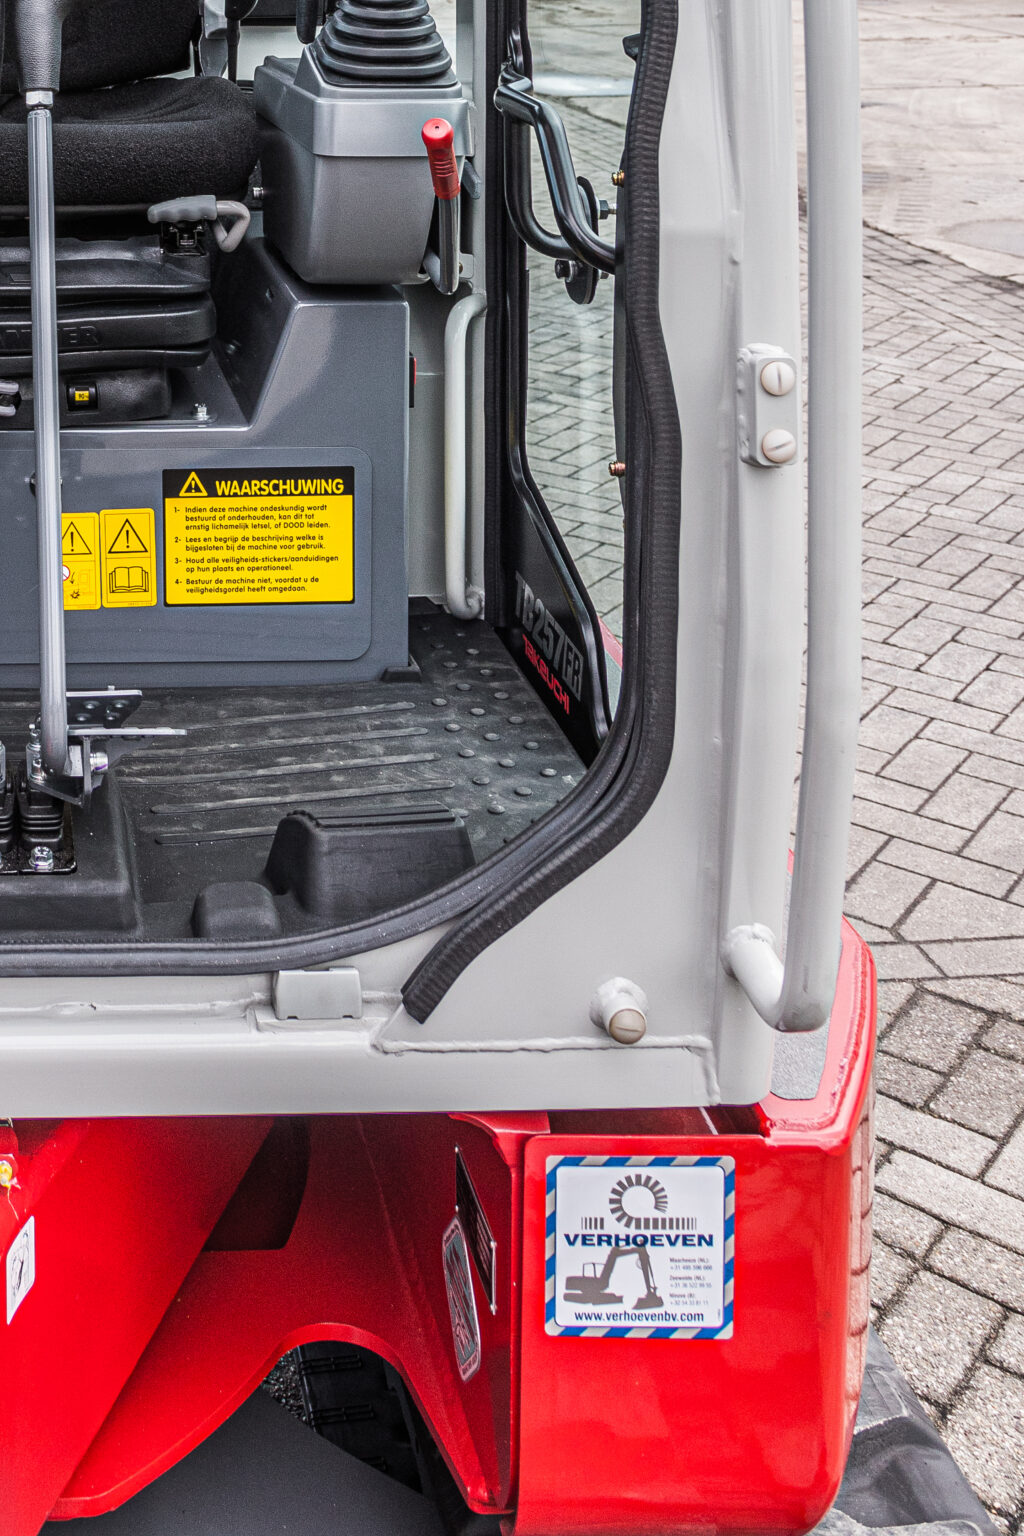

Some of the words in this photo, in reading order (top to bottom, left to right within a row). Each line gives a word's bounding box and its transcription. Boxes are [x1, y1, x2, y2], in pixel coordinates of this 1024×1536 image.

[215, 478, 345, 496] WAARSCHUWING
[260, 504, 305, 513] ondeskundig
[227, 513, 276, 521] onderhouden,
[185, 524, 210, 532] ernstig
[251, 522, 272, 530] letsel,
[283, 521, 305, 529] DOOD
[214, 535, 239, 544] begrijp
[252, 534, 294, 543] beschrijving
[185, 544, 224, 553] bijgesloten
[226, 544, 235, 552] bij
[297, 542, 325, 551] gebruik.
[212, 565, 234, 573] plaats
[247, 564, 293, 573] operationeel.
[186, 586, 245, 595] veiligheidsgordel
[268, 585, 307, 594] omgedaan.
[514, 569, 585, 702] TB257FR
[563, 1233, 714, 1248] VERHOEVEN
[574, 1309, 705, 1323] www.verhoevenbv.com
